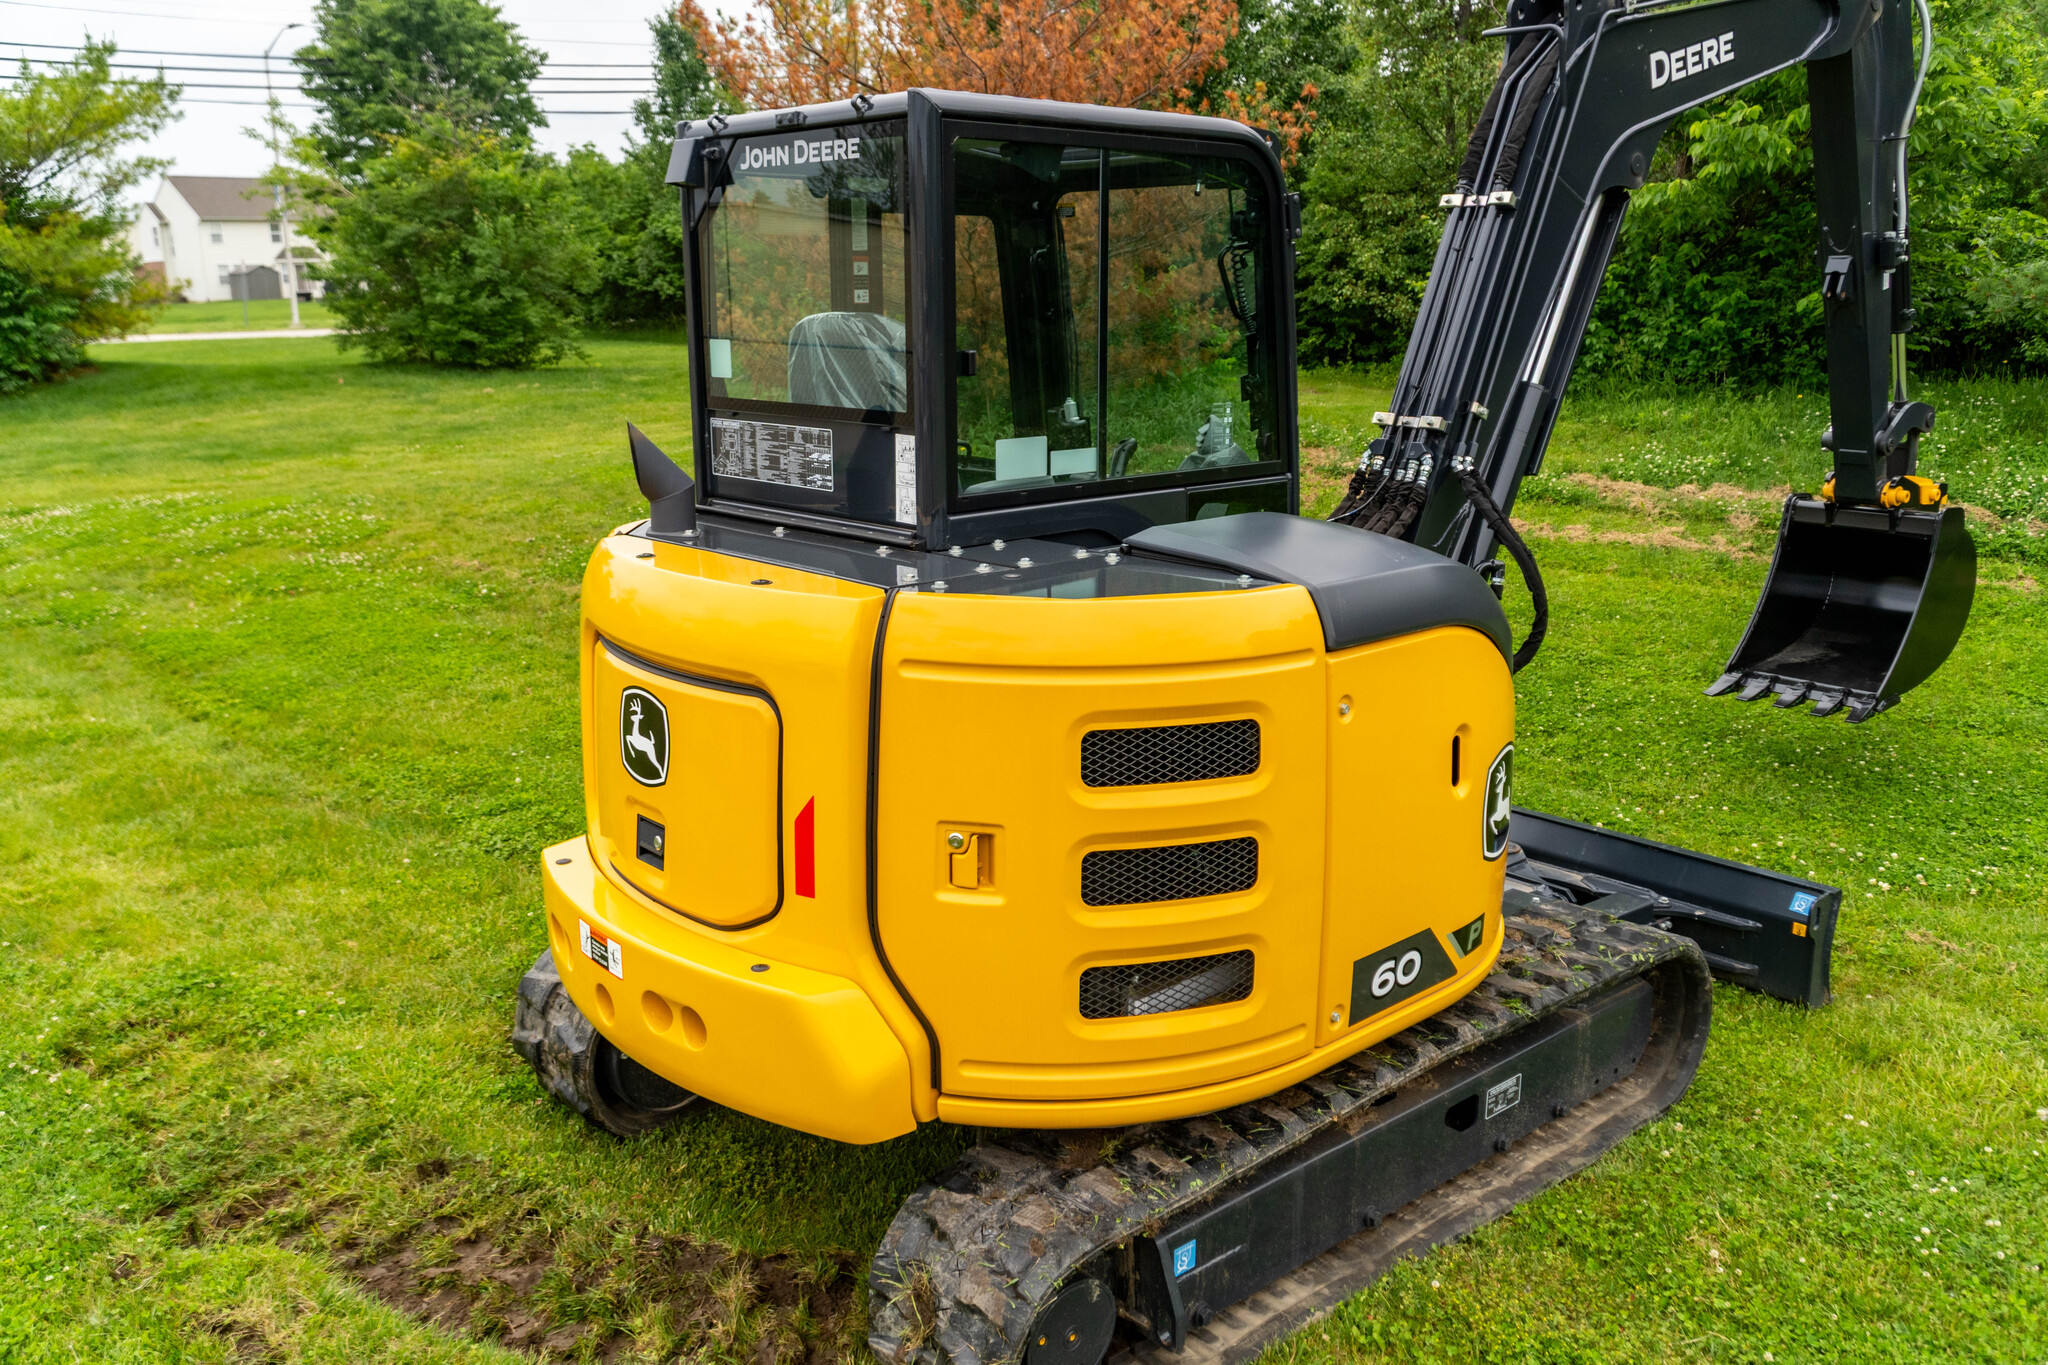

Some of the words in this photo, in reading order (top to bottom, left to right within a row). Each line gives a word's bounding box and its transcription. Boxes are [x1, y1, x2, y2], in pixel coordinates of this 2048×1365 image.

[1649, 31, 1735, 90] DEERE
[740, 145, 790, 170] JOHN
[793, 137, 861, 165] DEERE
[1371, 949, 1422, 997] 60
[1466, 919, 1482, 952] P
